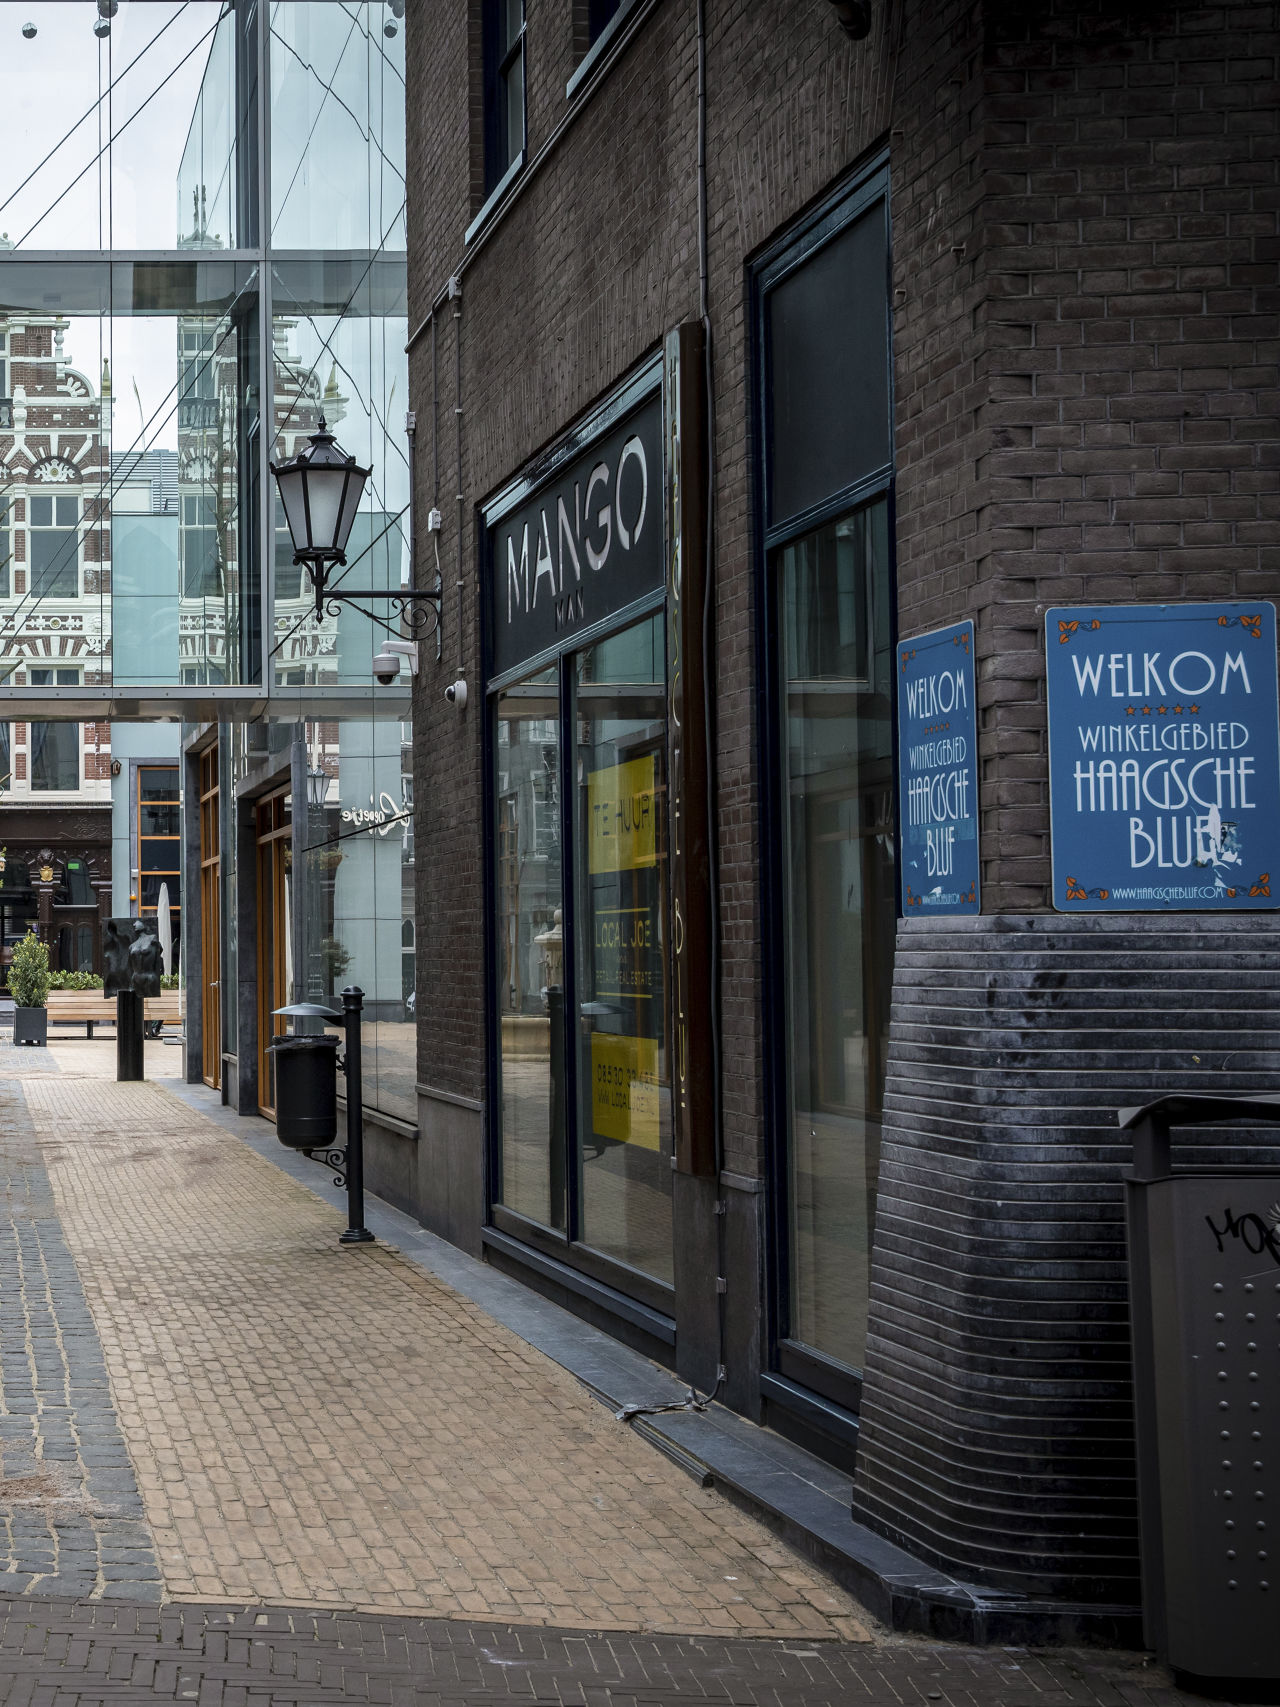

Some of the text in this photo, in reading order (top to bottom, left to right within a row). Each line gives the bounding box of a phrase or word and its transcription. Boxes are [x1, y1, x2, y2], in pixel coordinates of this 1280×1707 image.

[507, 434, 647, 623] MANGO
[554, 587, 584, 632] MAN
[906, 668, 967, 720] WELKOM
[1072, 651, 1252, 697] WELKOM
[909, 736, 967, 771] WINKELGEBIED
[1078, 722, 1249, 752] WINKELGEBIED
[908, 769, 969, 826] HAAGSCHE
[1073, 757, 1256, 812] HAAGSCHE
[593, 803, 609, 838] TE
[926, 826, 955, 876] BLUF
[1112, 885, 1224, 900] WWW.HAAGSCHEBLUF.COM
[595, 919, 651, 948] LOCAL JOE
